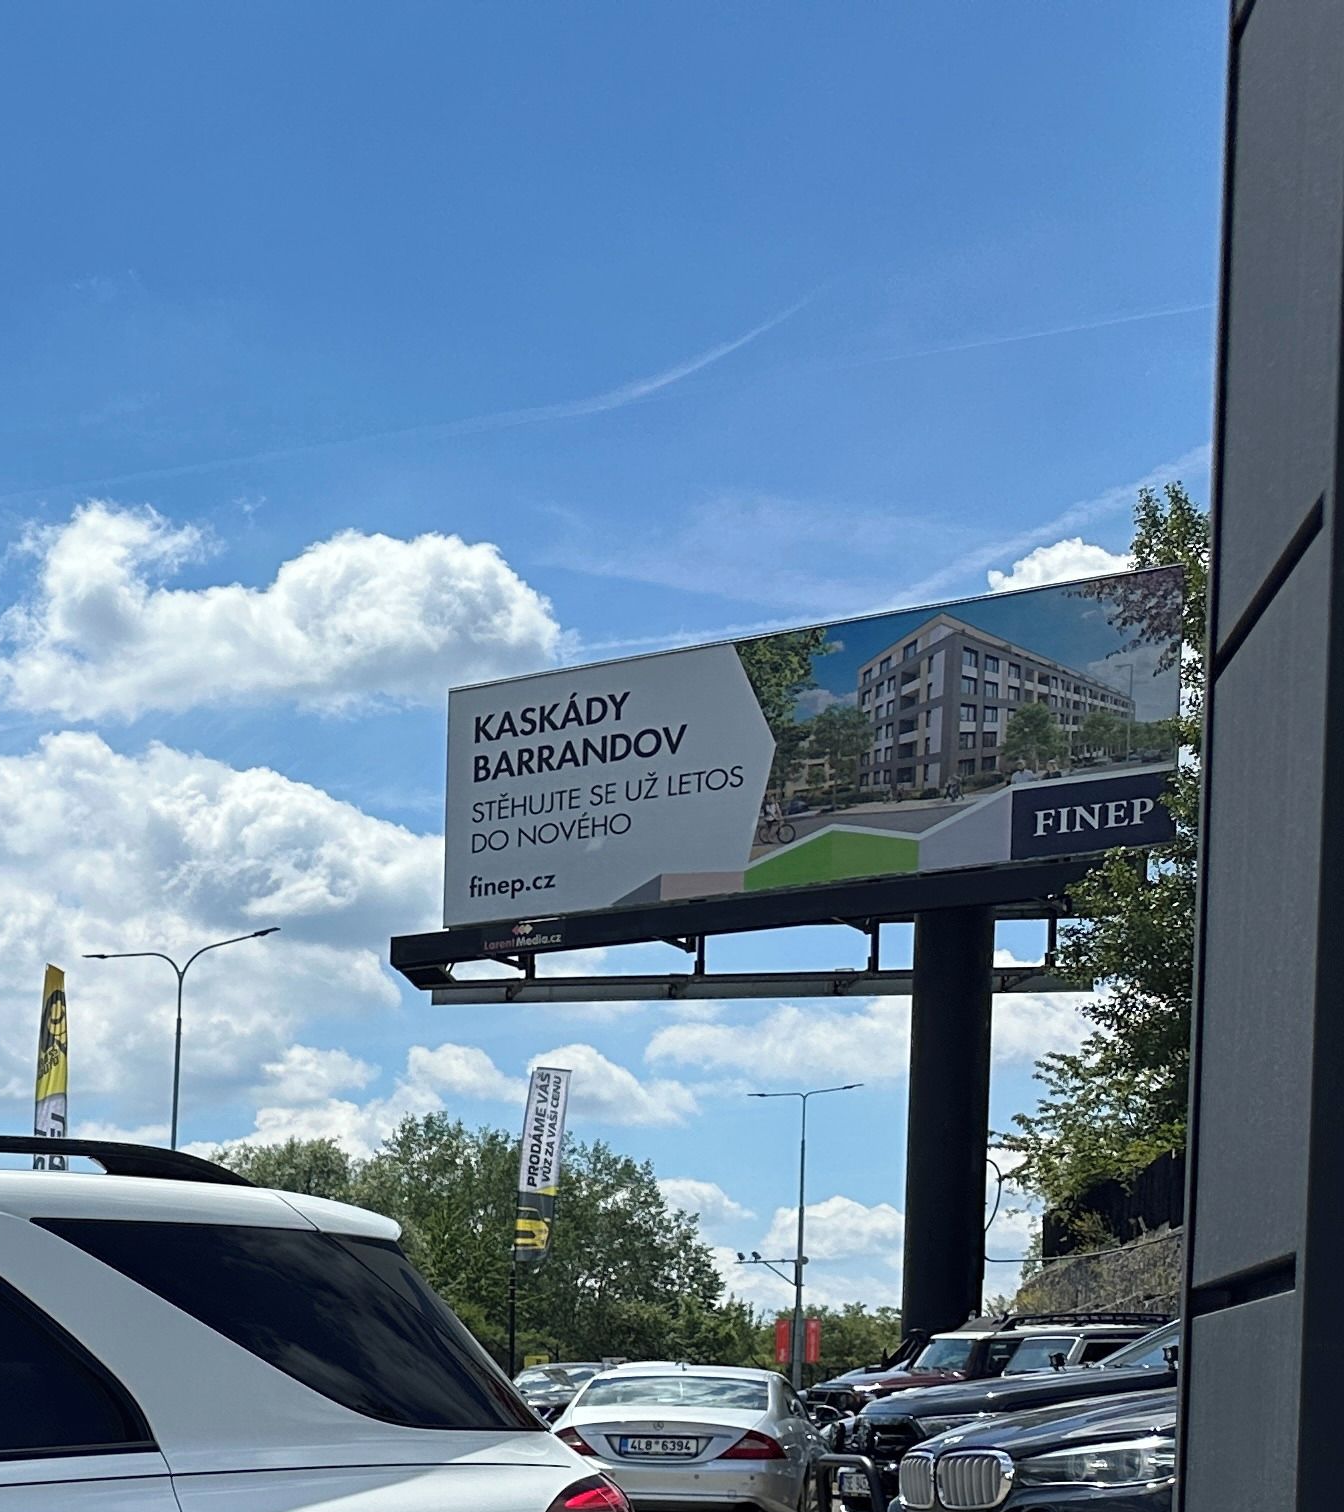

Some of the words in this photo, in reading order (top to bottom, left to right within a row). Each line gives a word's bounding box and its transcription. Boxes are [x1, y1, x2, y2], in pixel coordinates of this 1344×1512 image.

[473, 691, 631, 744] KASKÁDY
[473, 723, 688, 783] BARRANDOV
[471, 788, 581, 823] STĚHUJTE
[589, 782, 617, 807] SE
[625, 771, 659, 802] UŽ
[667, 765, 744, 797] LETOS
[471, 830, 509, 854] DO
[518, 812, 632, 848] NOVÉHO
[1033, 798, 1154, 837] FINEP
[469, 874, 557, 900] finep.cz
[536, 1071, 551, 1104] VÁŠ
[551, 1075, 561, 1107] CENU
[527, 1106, 547, 1187] PRODÁME
[630, 1440, 652, 1451] 4L8
[661, 1440, 691, 1451] 6394
